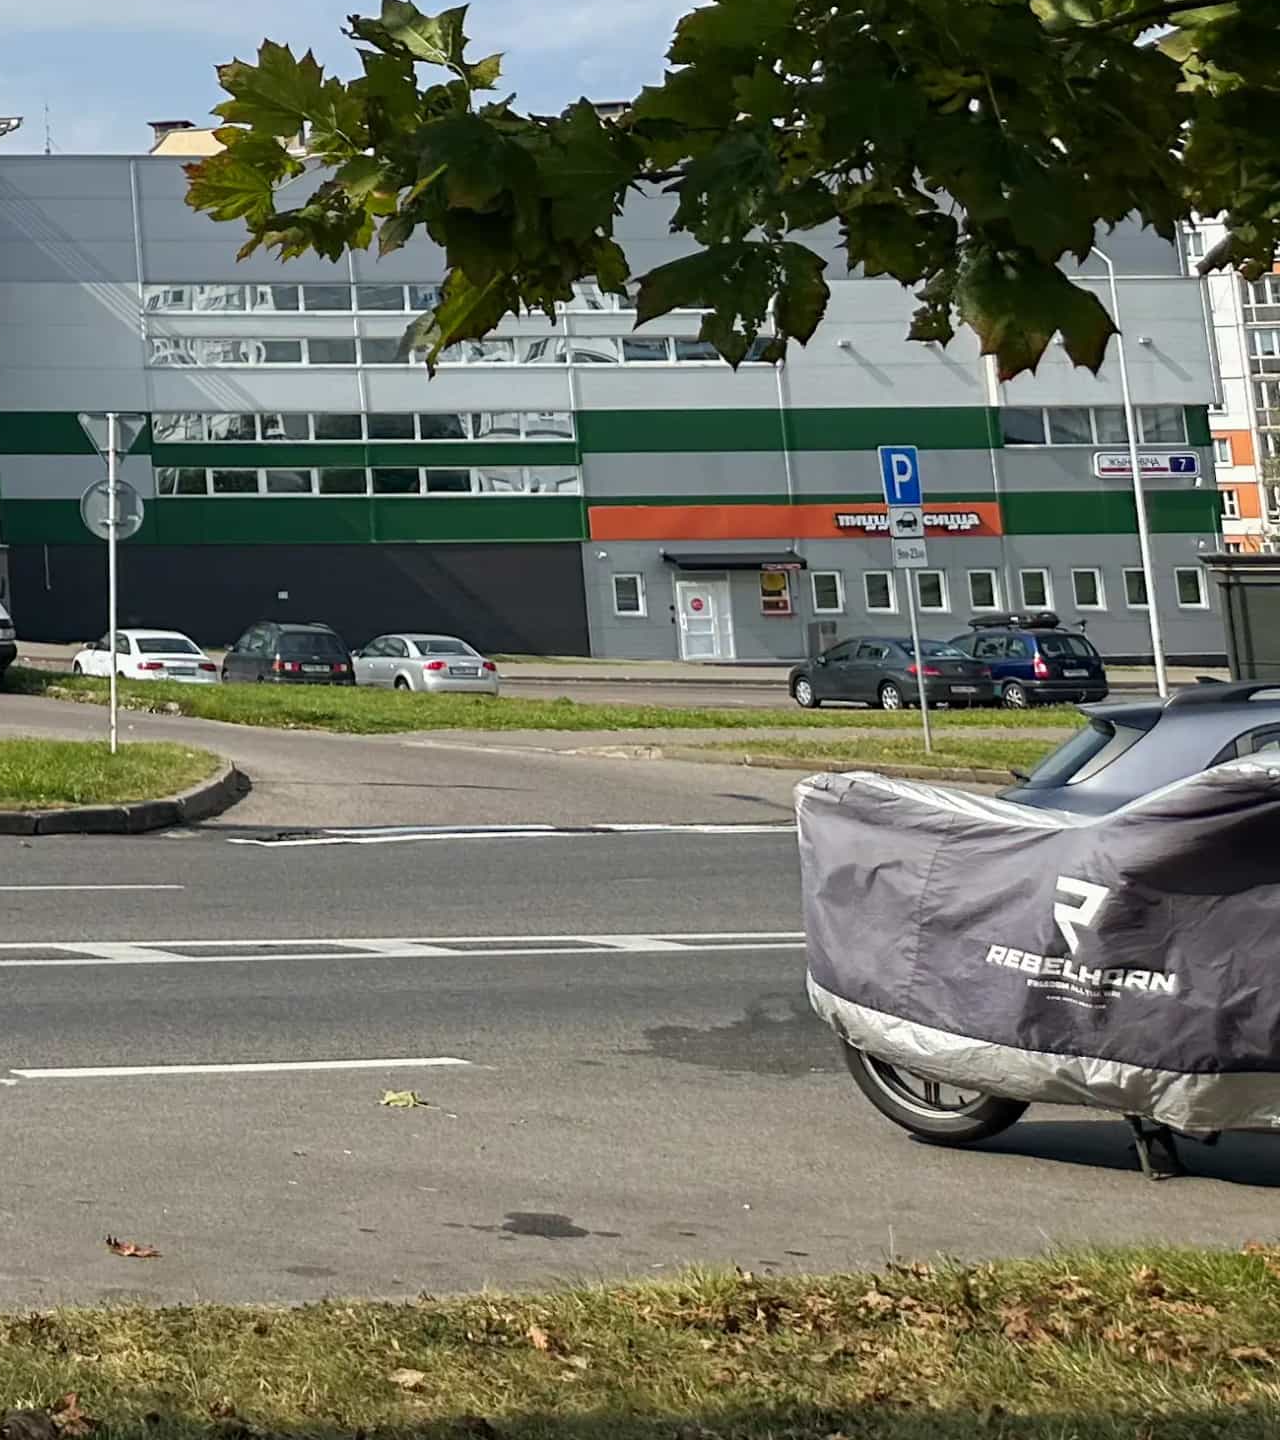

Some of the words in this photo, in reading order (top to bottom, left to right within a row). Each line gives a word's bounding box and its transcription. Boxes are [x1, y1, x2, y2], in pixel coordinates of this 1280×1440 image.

[891, 454, 913, 499] P
[1178, 458, 1186, 471] 7
[986, 944, 1176, 993] REBELHORN
